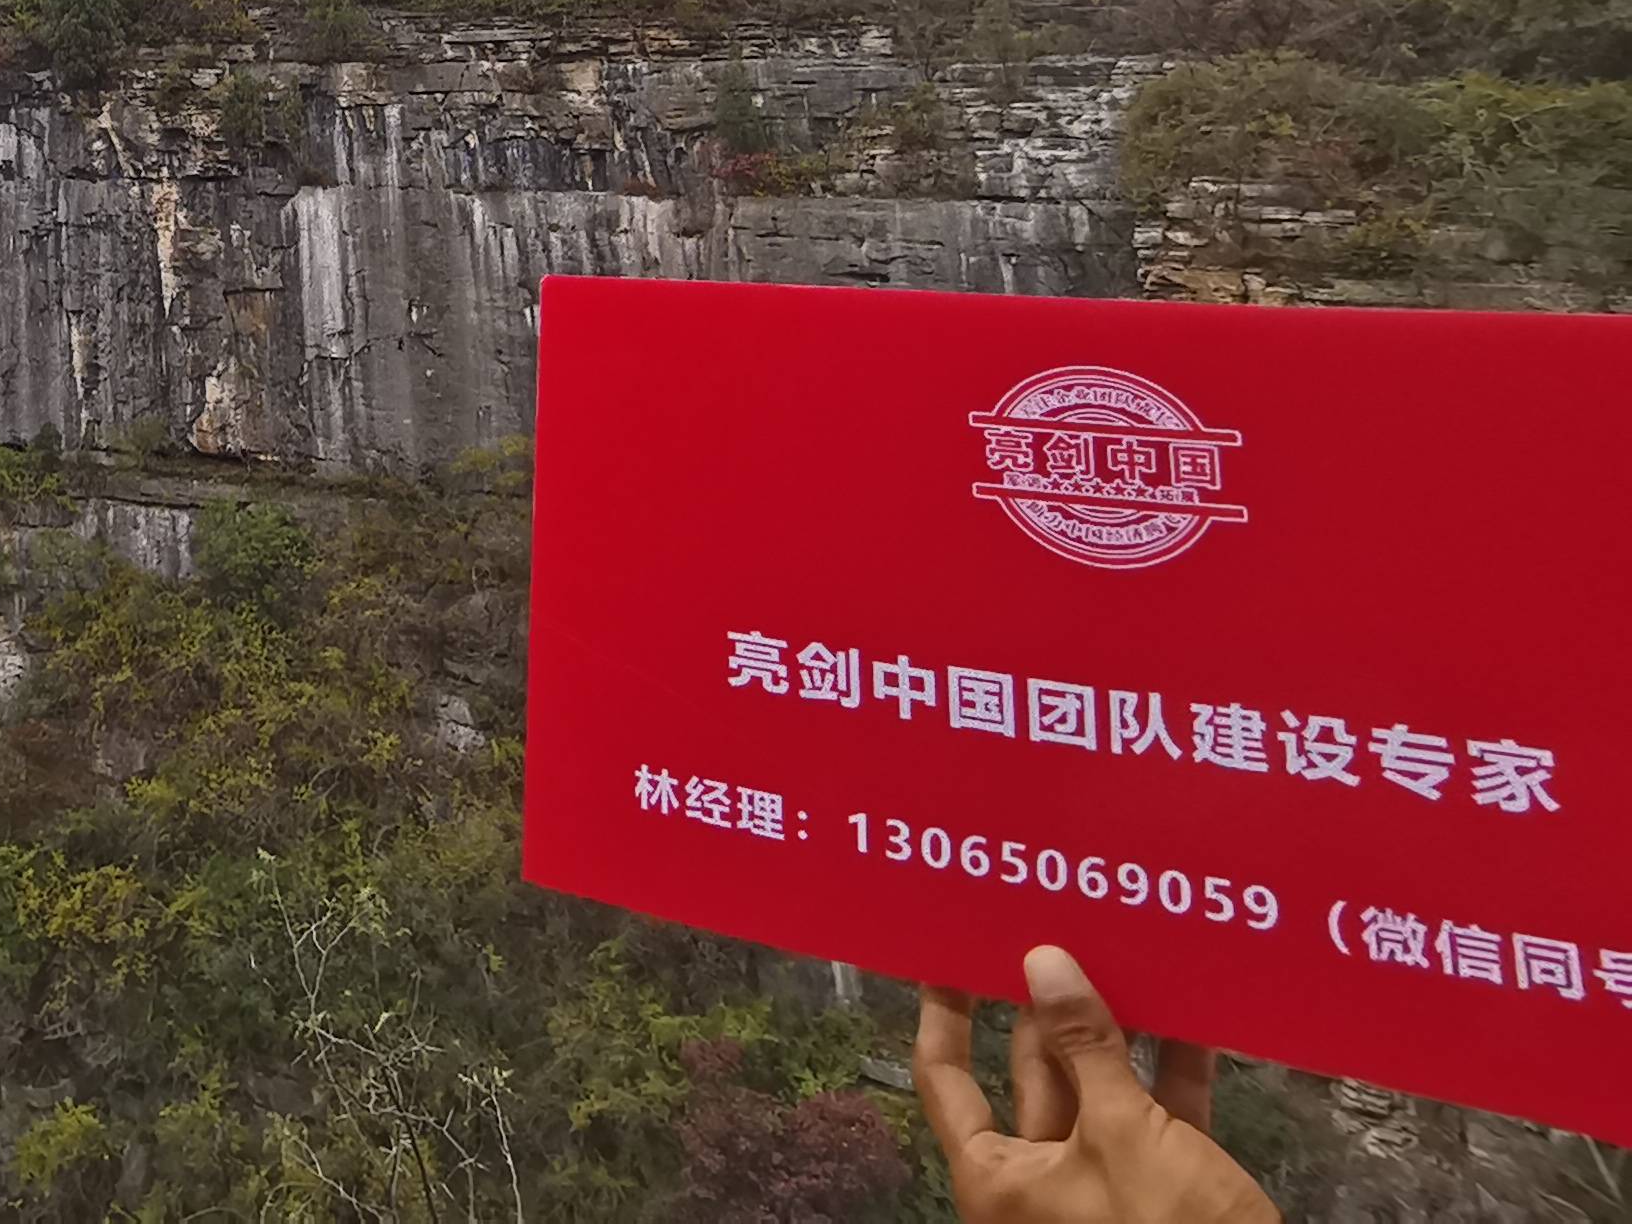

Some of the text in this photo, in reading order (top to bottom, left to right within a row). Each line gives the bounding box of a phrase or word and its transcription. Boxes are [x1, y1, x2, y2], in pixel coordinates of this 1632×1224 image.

[984, 429, 1221, 490] 亮剑中国
[727, 630, 1561, 813] 亮剑中国团队建设专家
[848, 812, 1279, 930] 13065069059
